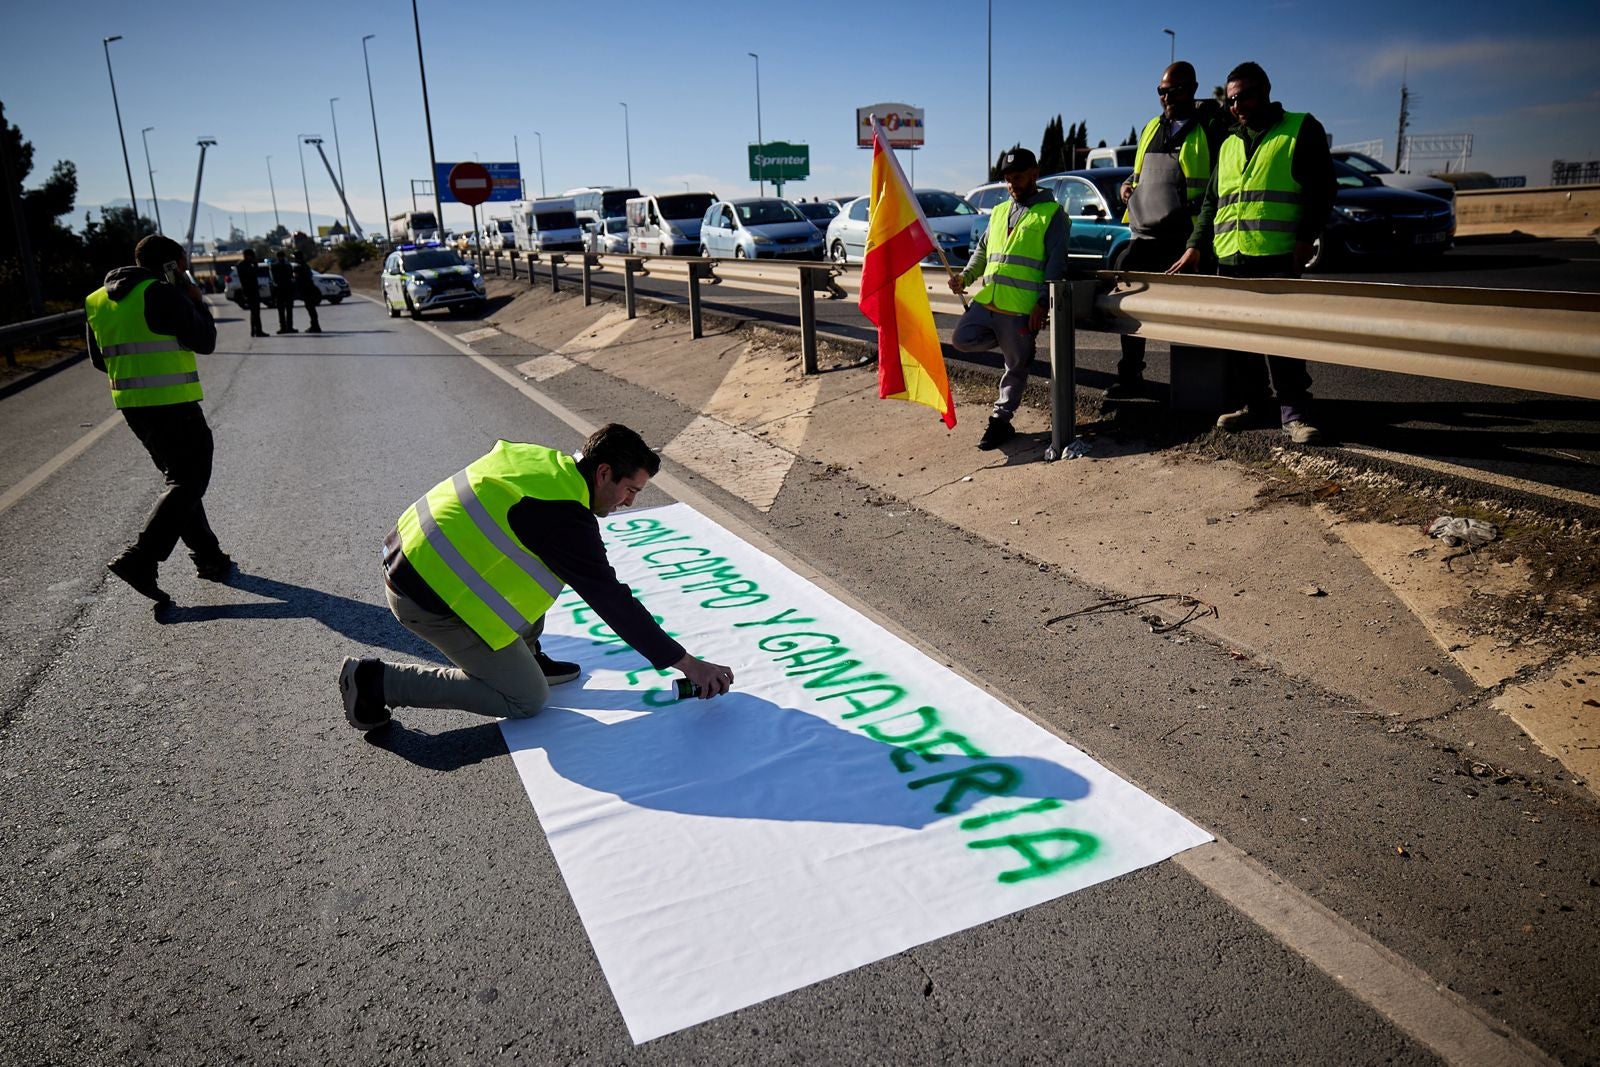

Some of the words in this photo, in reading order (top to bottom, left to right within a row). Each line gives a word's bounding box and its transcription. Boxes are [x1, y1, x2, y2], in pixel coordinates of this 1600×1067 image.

[753, 154, 807, 168] Sprinter
[606, 517, 694, 549] SIN
[642, 546, 771, 609] CAMPO
[732, 608, 817, 628] Y
[757, 631, 1103, 885] GANADERIA
